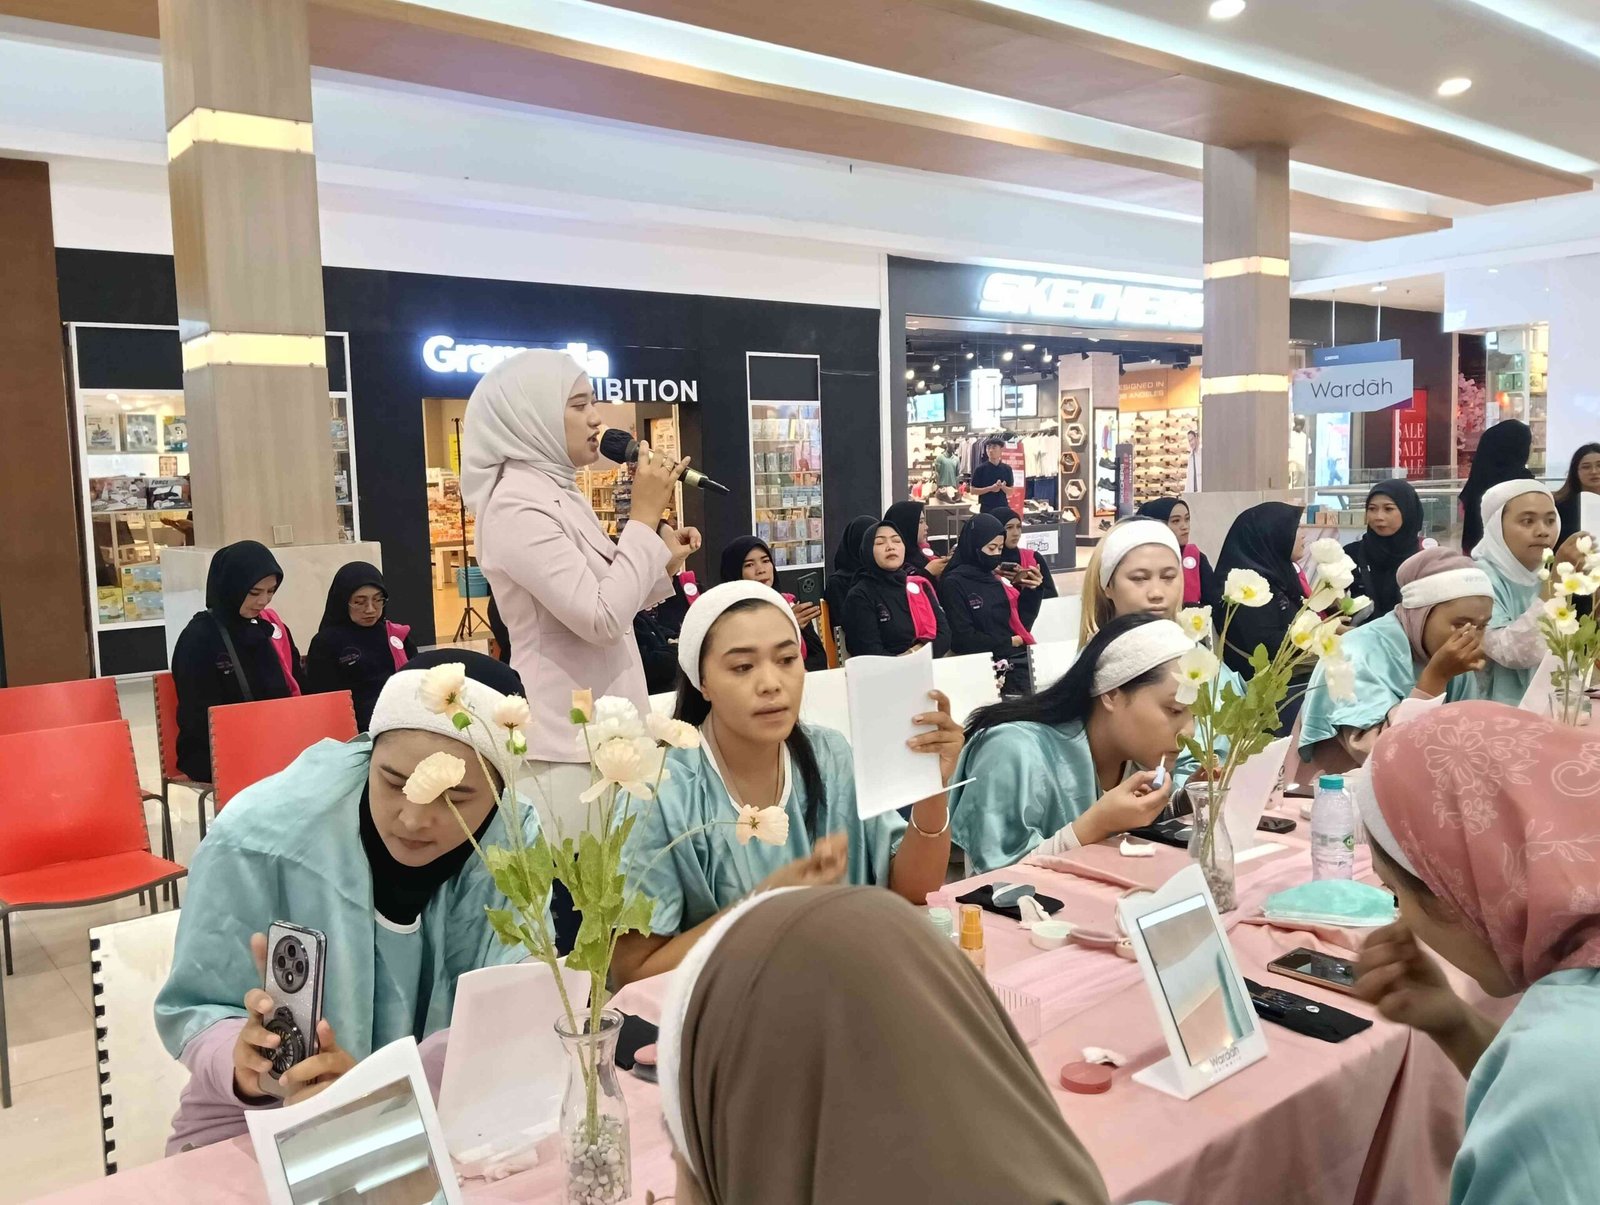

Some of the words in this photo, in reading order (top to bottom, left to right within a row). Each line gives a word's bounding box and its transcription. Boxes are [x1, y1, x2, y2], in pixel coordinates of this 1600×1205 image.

[422, 335, 610, 378] Gramia
[1119, 382, 1154, 391] ESIGNED
[1400, 459, 1424, 475] ALE
